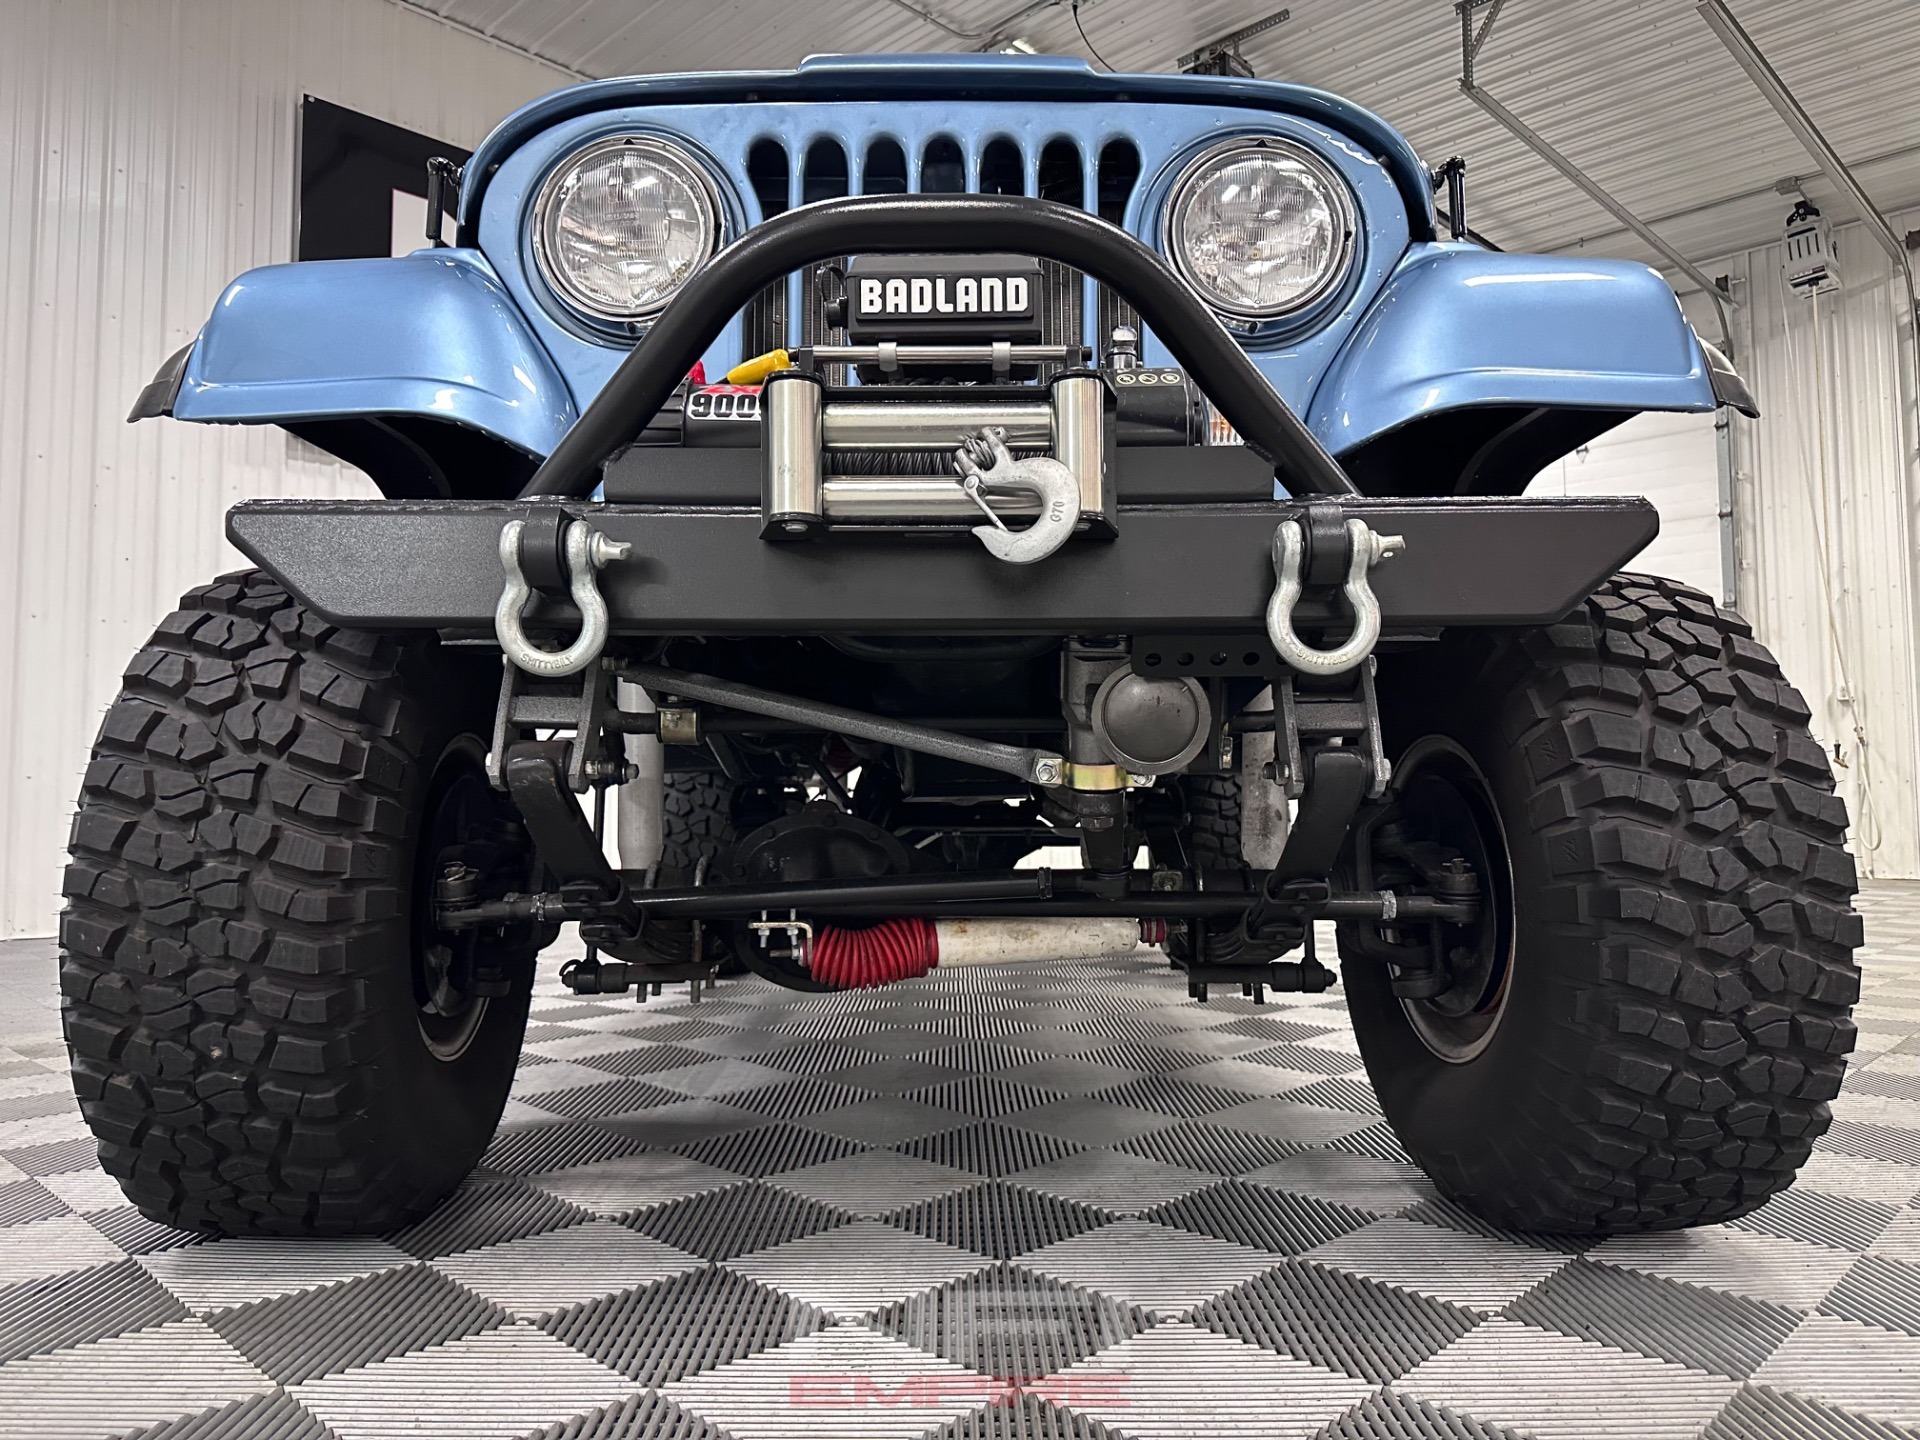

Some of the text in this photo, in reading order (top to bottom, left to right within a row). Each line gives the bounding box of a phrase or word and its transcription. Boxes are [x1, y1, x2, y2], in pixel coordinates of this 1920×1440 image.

[860, 278, 1028, 313] BADLAND
[690, 394, 762, 419] 900
[1050, 501, 1065, 522] G70
